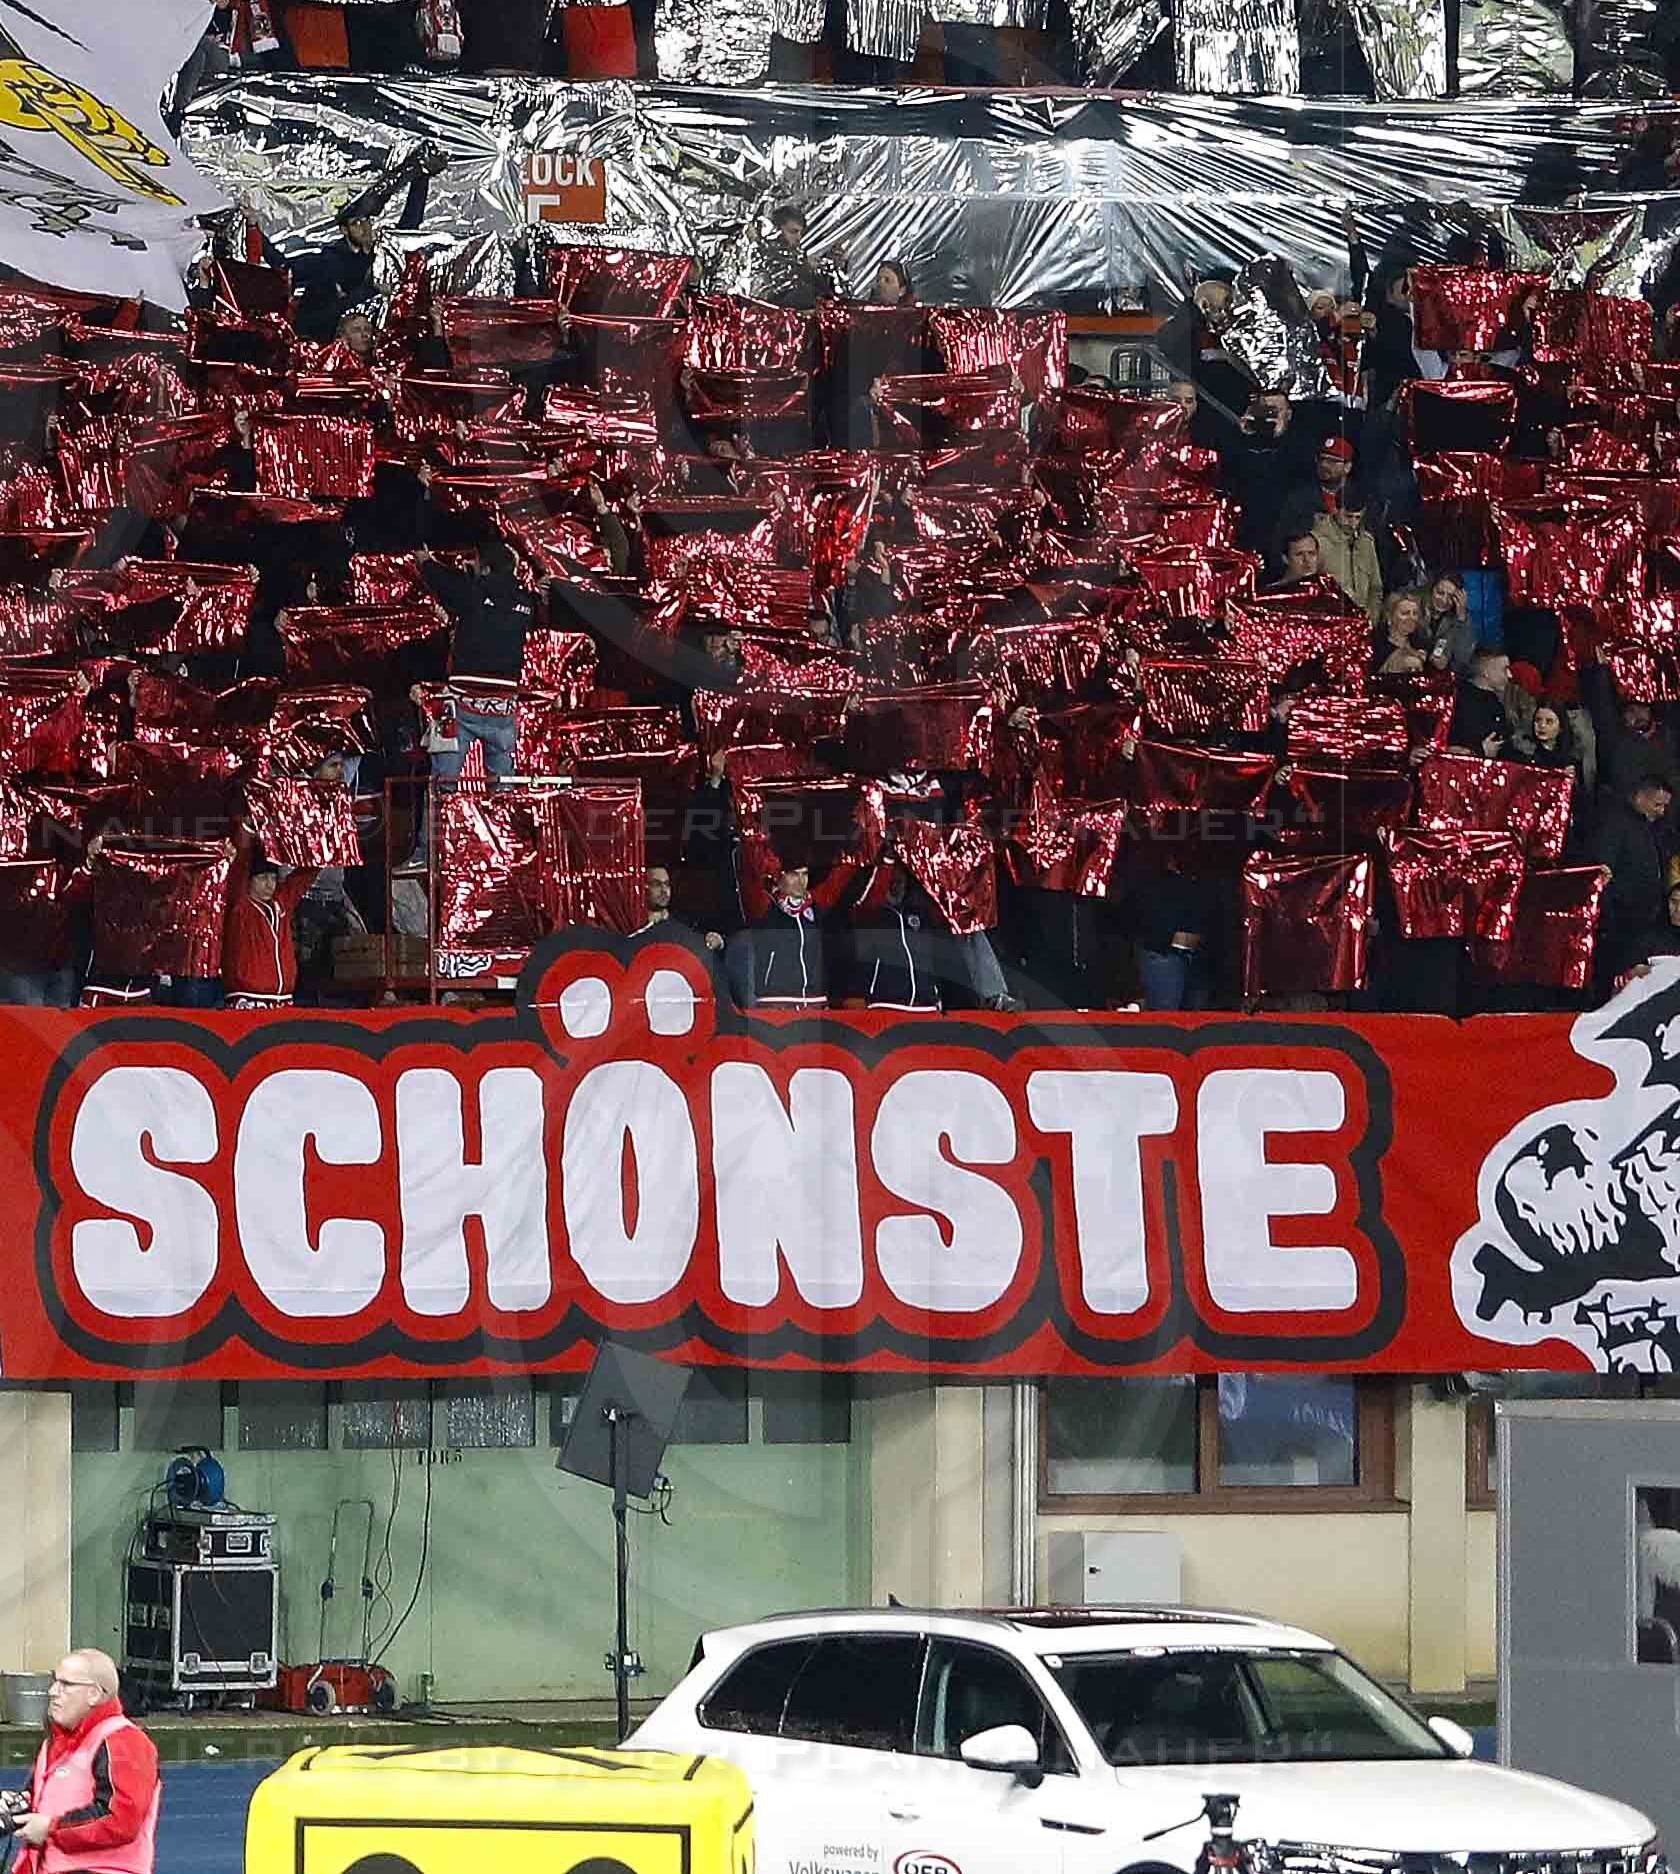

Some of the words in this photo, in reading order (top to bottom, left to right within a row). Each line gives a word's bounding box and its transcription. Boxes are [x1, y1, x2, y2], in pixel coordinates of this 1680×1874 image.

[70, 969, 1359, 1318] SCHÖNSTE
[823, 1844, 864, 1858] powered
[866, 1843, 879, 1862] by
